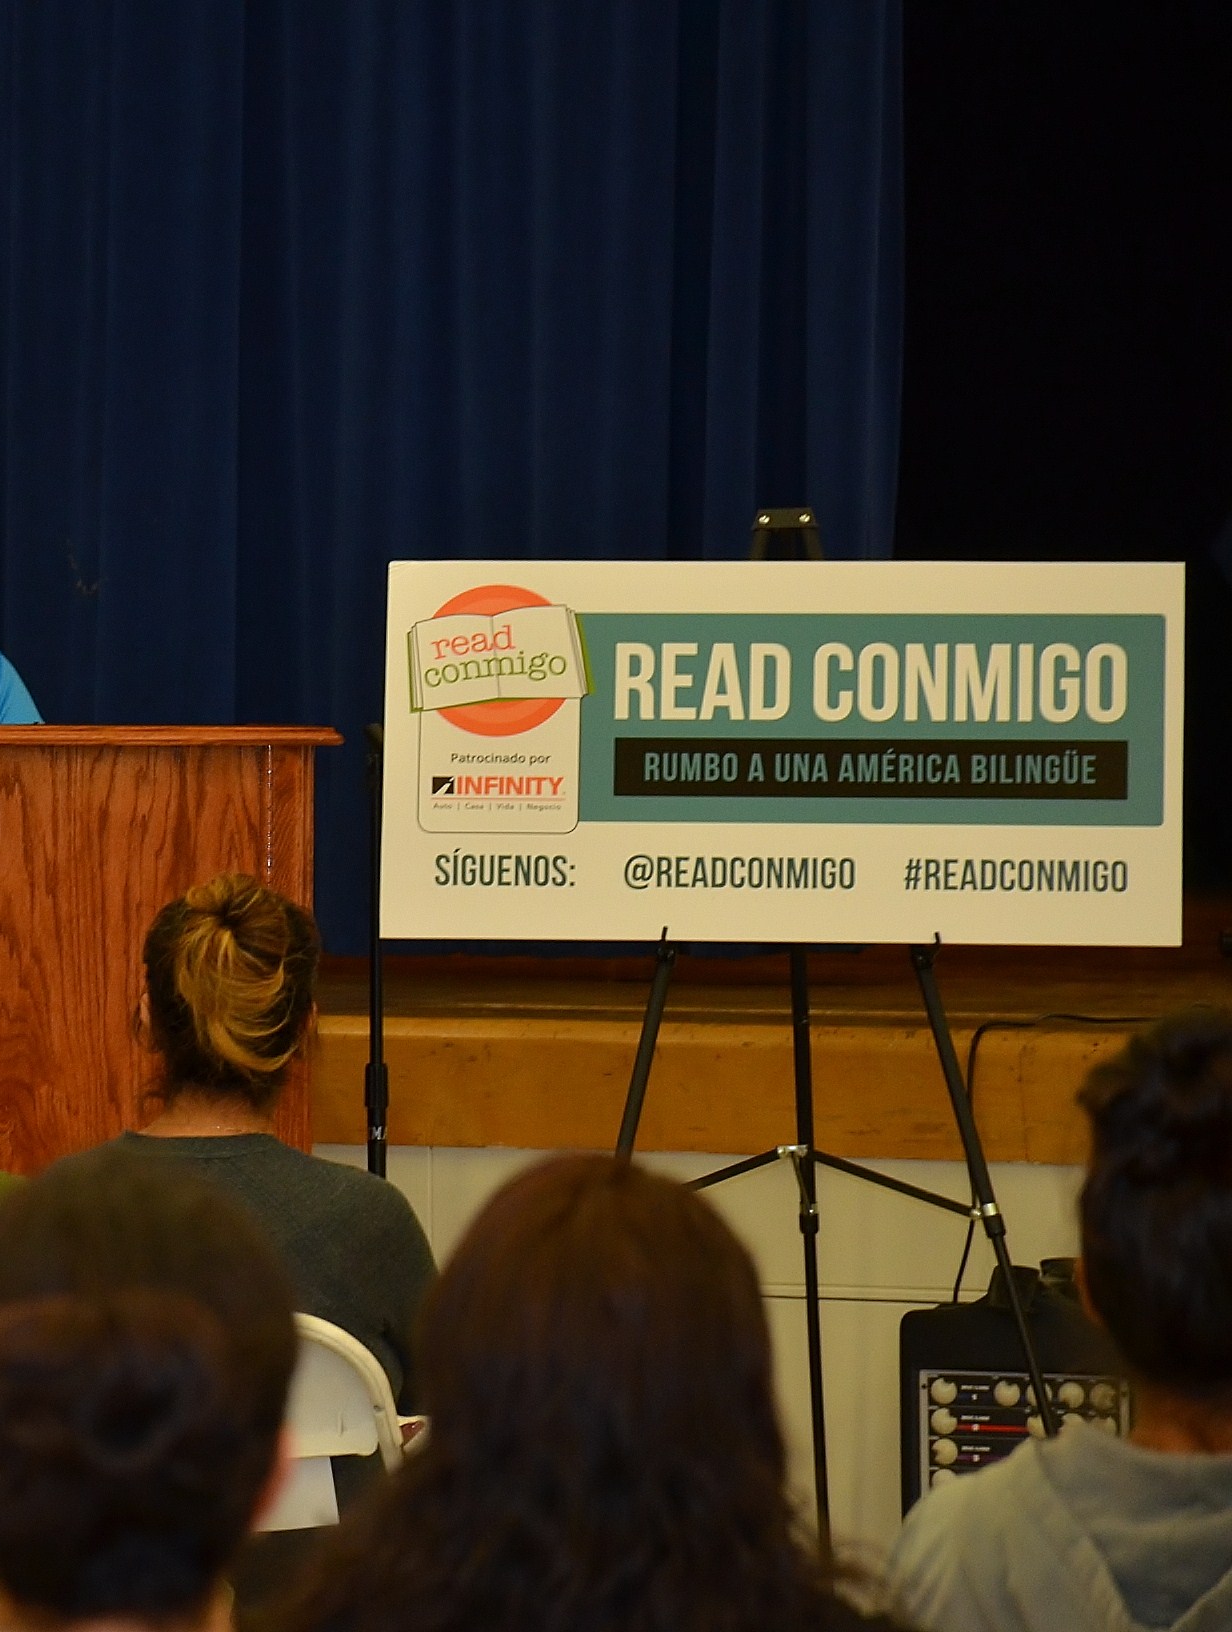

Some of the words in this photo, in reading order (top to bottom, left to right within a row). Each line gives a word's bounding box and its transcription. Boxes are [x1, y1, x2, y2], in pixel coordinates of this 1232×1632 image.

[431, 624, 516, 660] read
[425, 651, 567, 688] conmigo
[614, 641, 791, 721] READ
[813, 641, 1128, 725] CONMIGO
[451, 753, 526, 764] Patrocinado
[529, 754, 552, 766] por
[644, 752, 739, 783] RUMBO
[747, 751, 765, 782] A
[774, 752, 829, 783] UNA
[838, 748, 961, 784] AMÉRICA
[971, 748, 1097, 785] BILINGÜE
[457, 776, 564, 796] INFINITY
[433, 802, 452, 811] Auto
[465, 802, 484, 811] Casa
[496, 802, 514, 811] Vida
[526, 802, 562, 812] Negocio
[434, 848, 577, 888] SÍGUENOS:
[623, 854, 855, 890] @READCONMIGO
[904, 858, 1129, 893] #READCONMIGO
